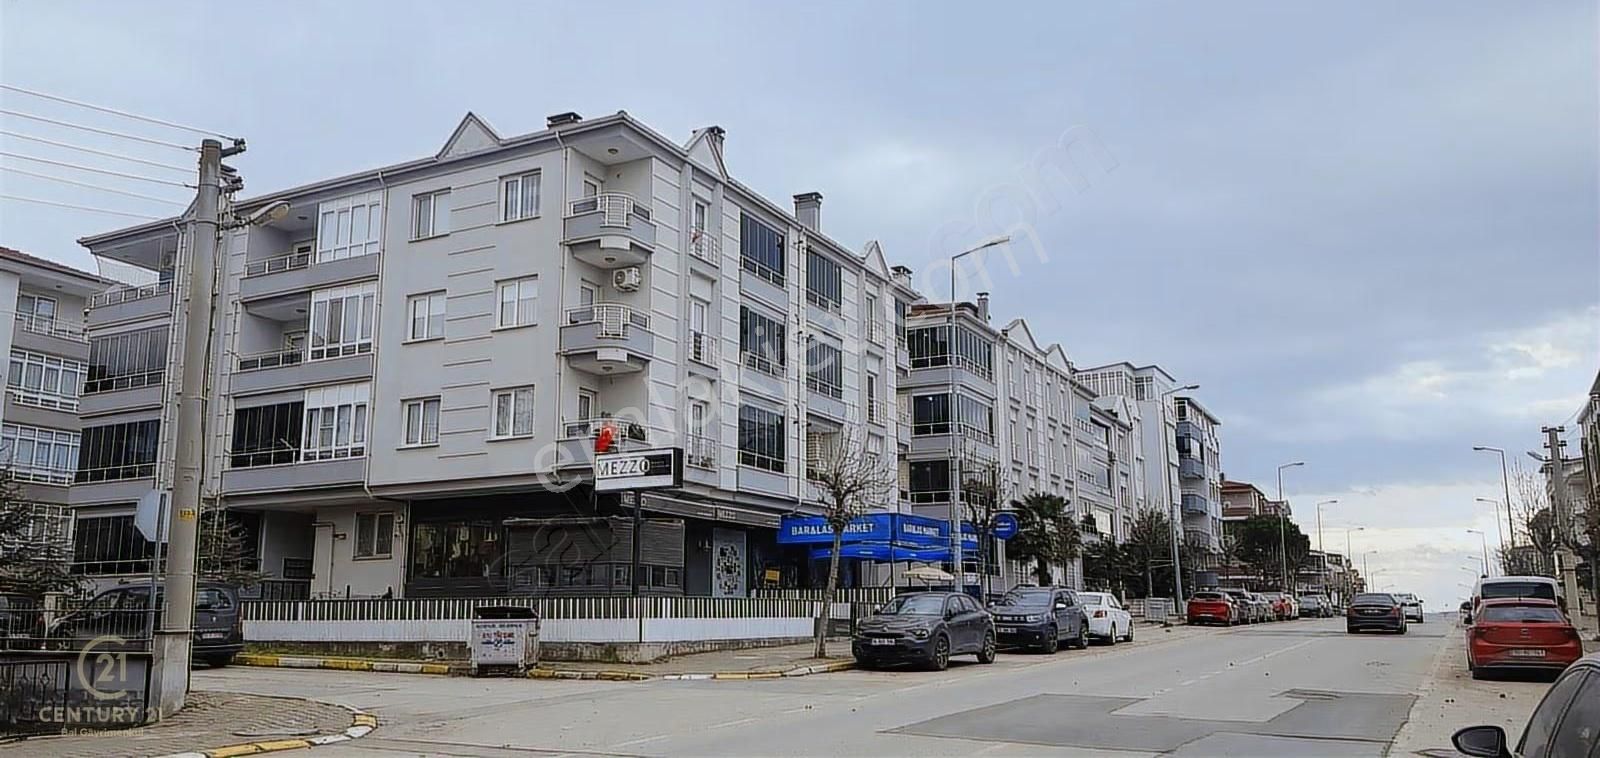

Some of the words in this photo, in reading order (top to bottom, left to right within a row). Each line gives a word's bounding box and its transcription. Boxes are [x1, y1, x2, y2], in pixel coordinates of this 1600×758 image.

[597, 459, 650, 477] MEZZO
[622, 493, 649, 507] MEO
[791, 524, 834, 536] BARALAS
[839, 523, 875, 534] ARKET
